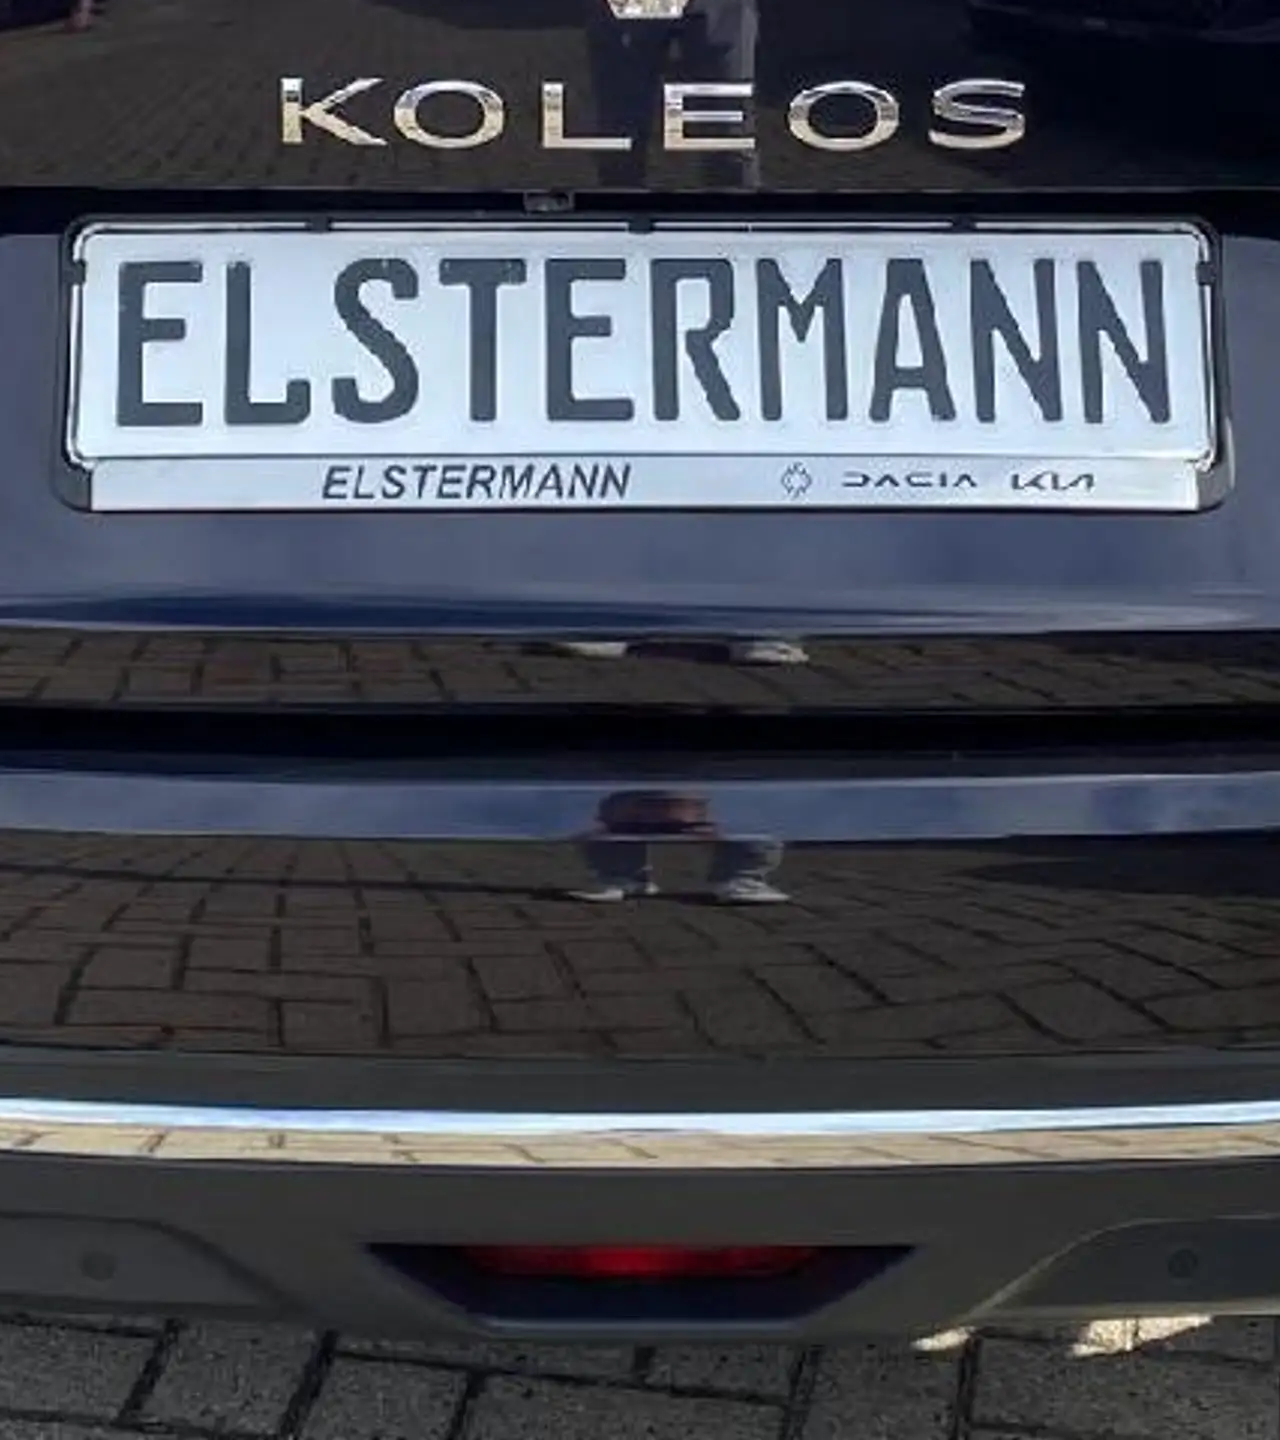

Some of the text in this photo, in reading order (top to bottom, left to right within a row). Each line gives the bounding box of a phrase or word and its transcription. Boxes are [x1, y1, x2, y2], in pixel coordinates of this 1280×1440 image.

[280, 77, 1026, 149] KOLEOS
[116, 258, 1170, 426] ELSTERMANN
[322, 463, 1095, 500] ELSTERMANN DACIA KIA
